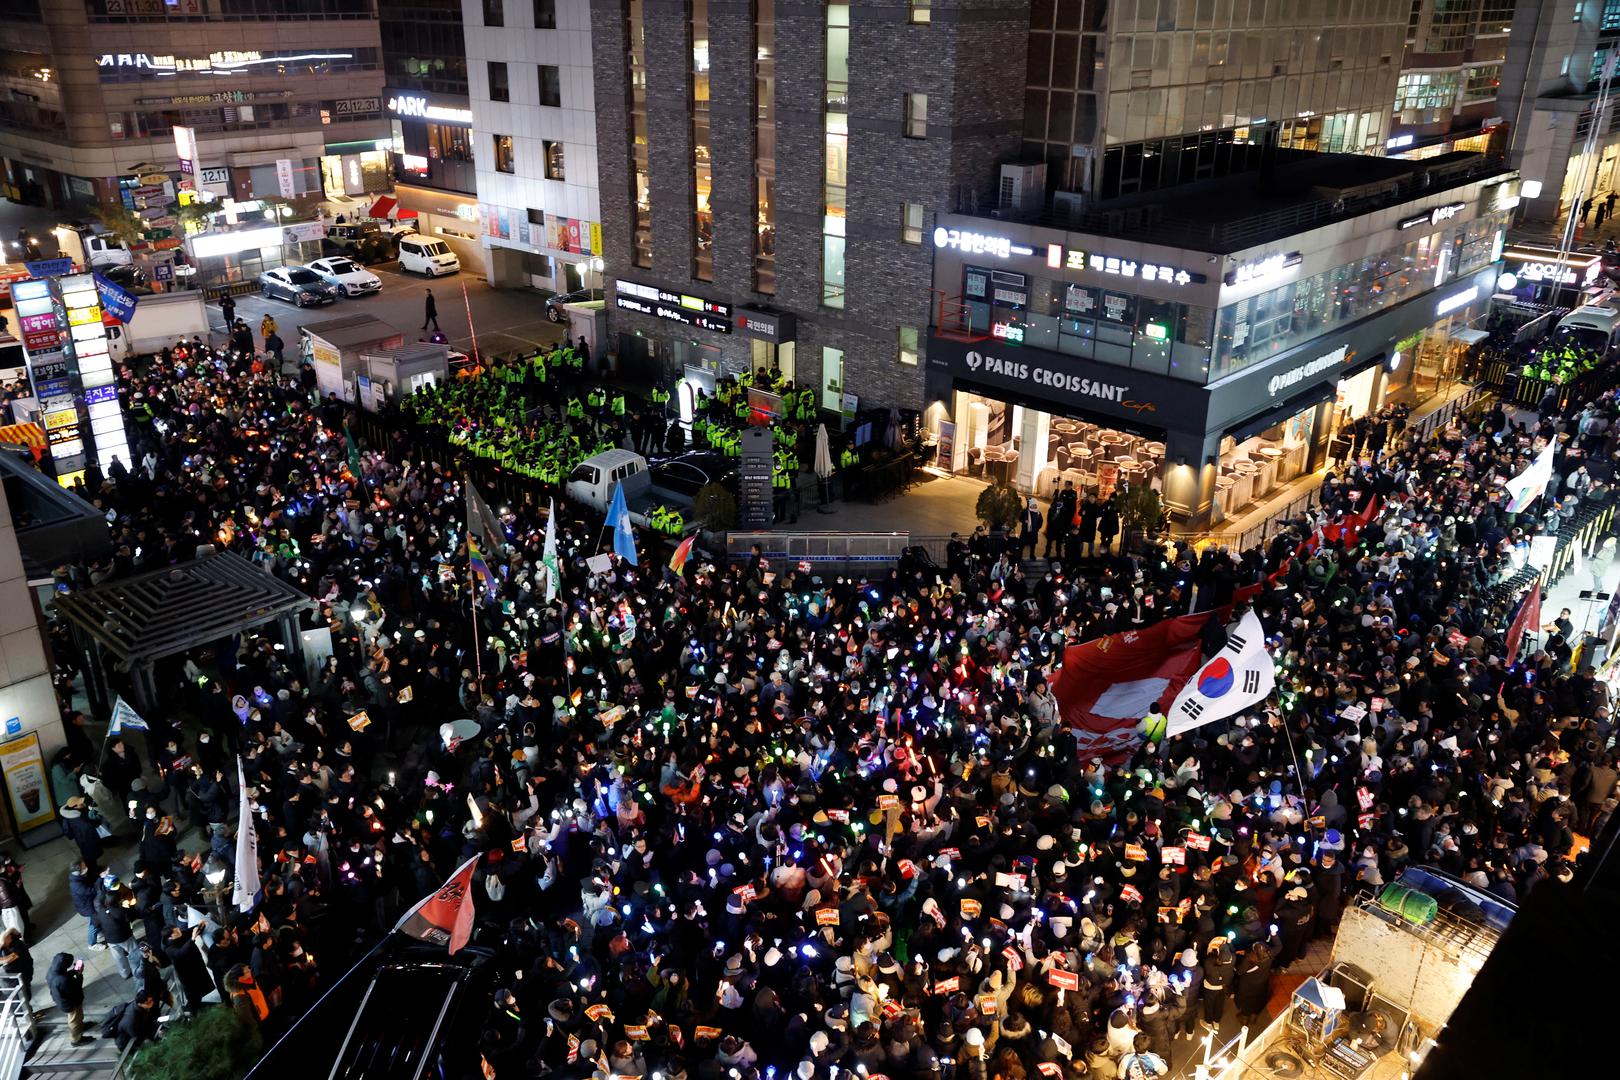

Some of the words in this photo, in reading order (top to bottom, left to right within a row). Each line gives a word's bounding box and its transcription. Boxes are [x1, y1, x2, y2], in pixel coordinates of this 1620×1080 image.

[746, 318, 775, 336] 국민의힘
[984, 355, 1029, 380] PARIS
[1032, 366, 1125, 402] CROISSANT
